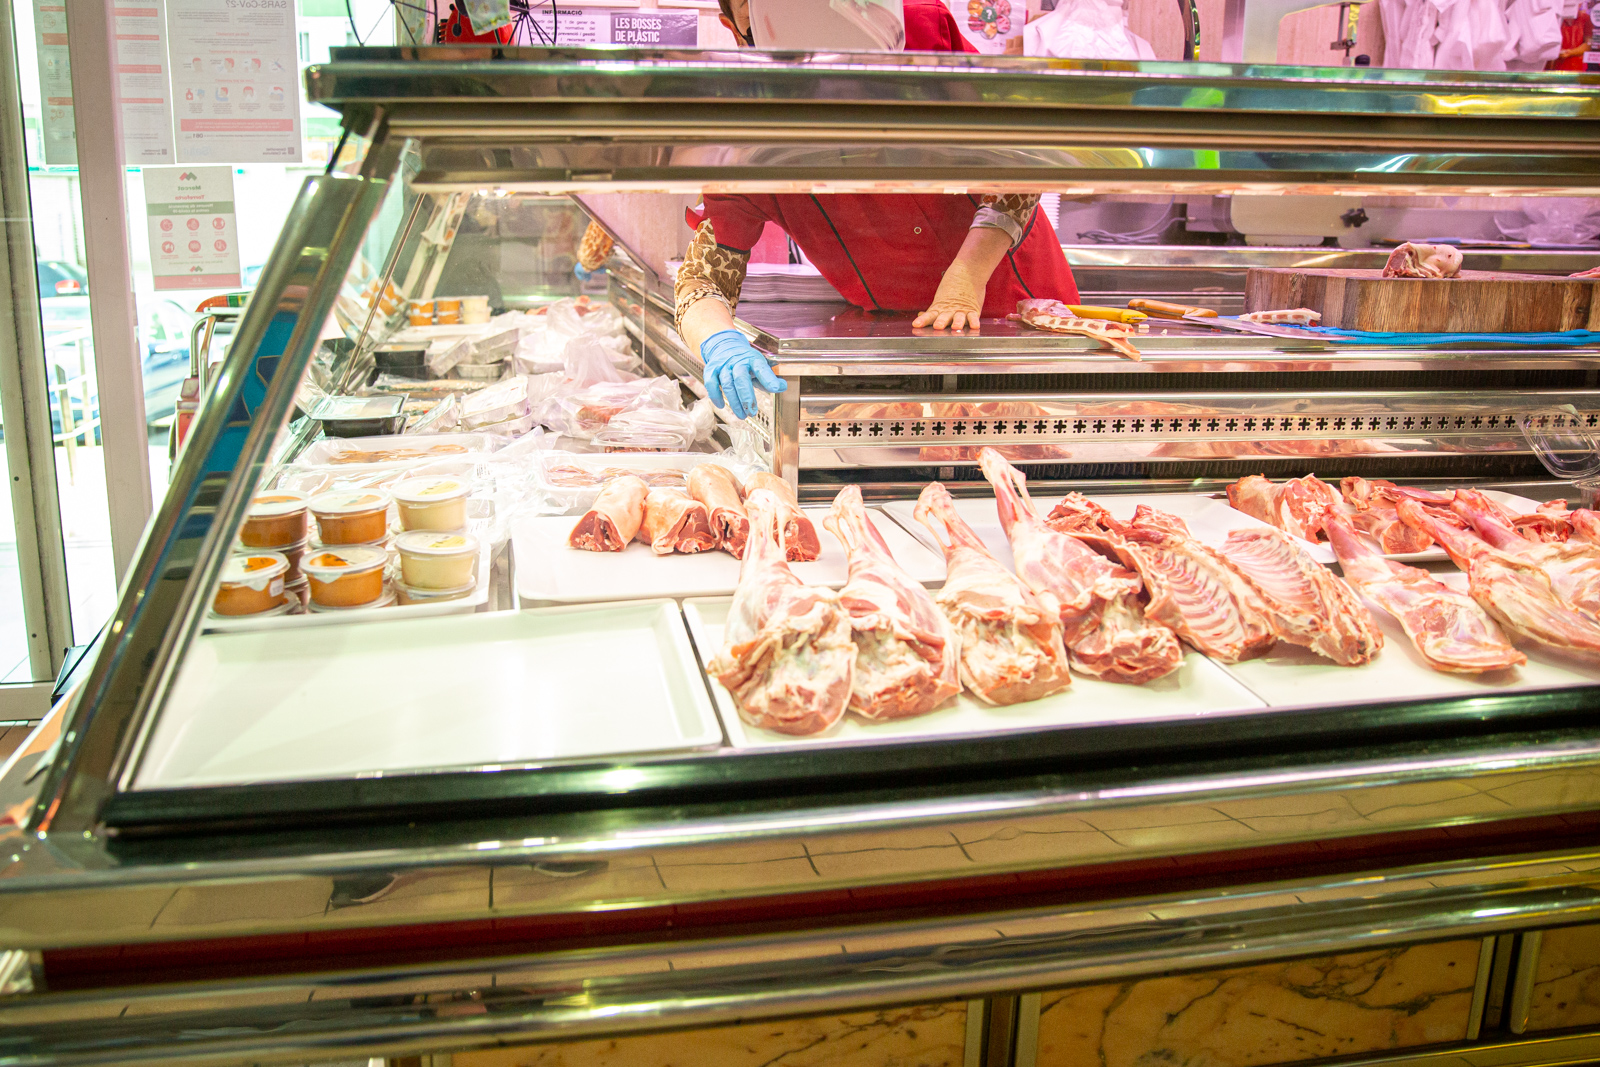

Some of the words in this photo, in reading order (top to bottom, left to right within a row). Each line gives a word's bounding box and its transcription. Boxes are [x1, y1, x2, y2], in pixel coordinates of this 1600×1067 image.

[615, 17, 630, 29] LES
[631, 17, 662, 30] BOSSES
[615, 30, 626, 42] DE
[627, 28, 660, 43] PLÀSTIC
